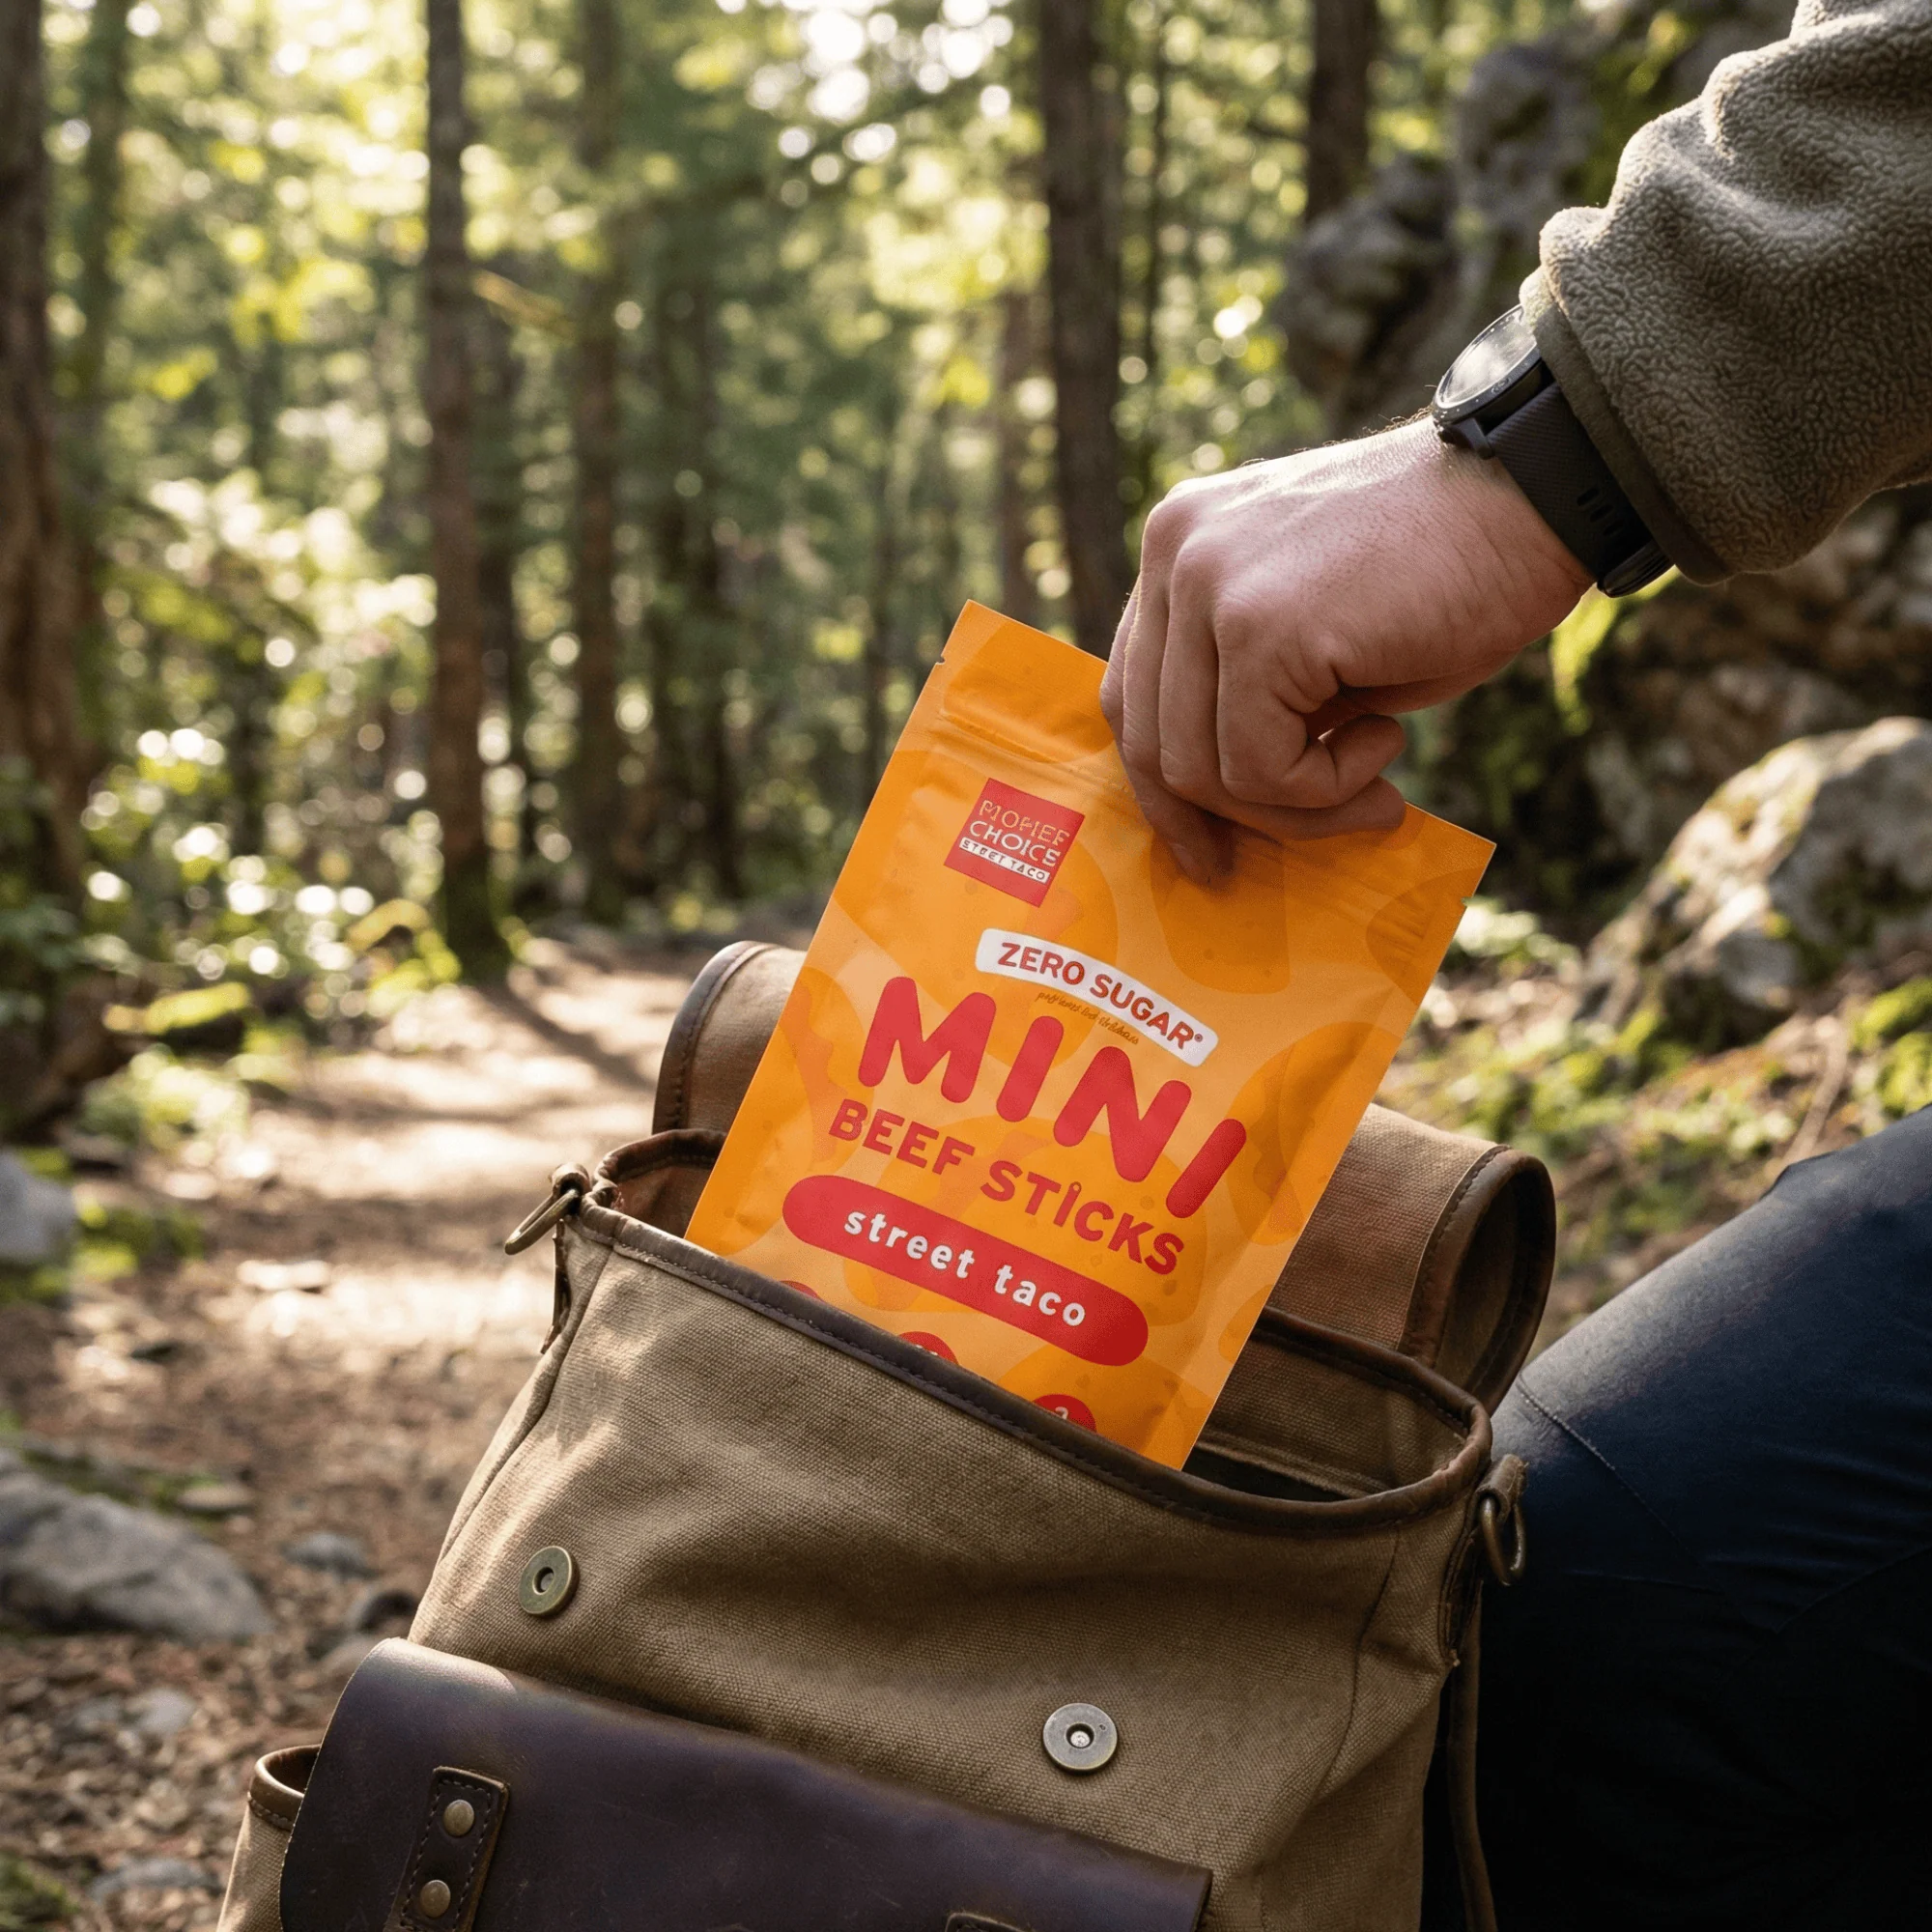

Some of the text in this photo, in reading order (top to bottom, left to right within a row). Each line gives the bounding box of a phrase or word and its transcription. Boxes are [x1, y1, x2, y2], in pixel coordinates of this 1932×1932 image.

[969, 820, 1062, 867] CHOICE
[1010, 861, 1045, 880] TACO
[998, 942, 1085, 985] ZERO
[858, 976, 1247, 1219] MINI
[829, 1098, 1184, 1275] BEEF STICKS
[843, 1210, 1086, 1326] street taco
